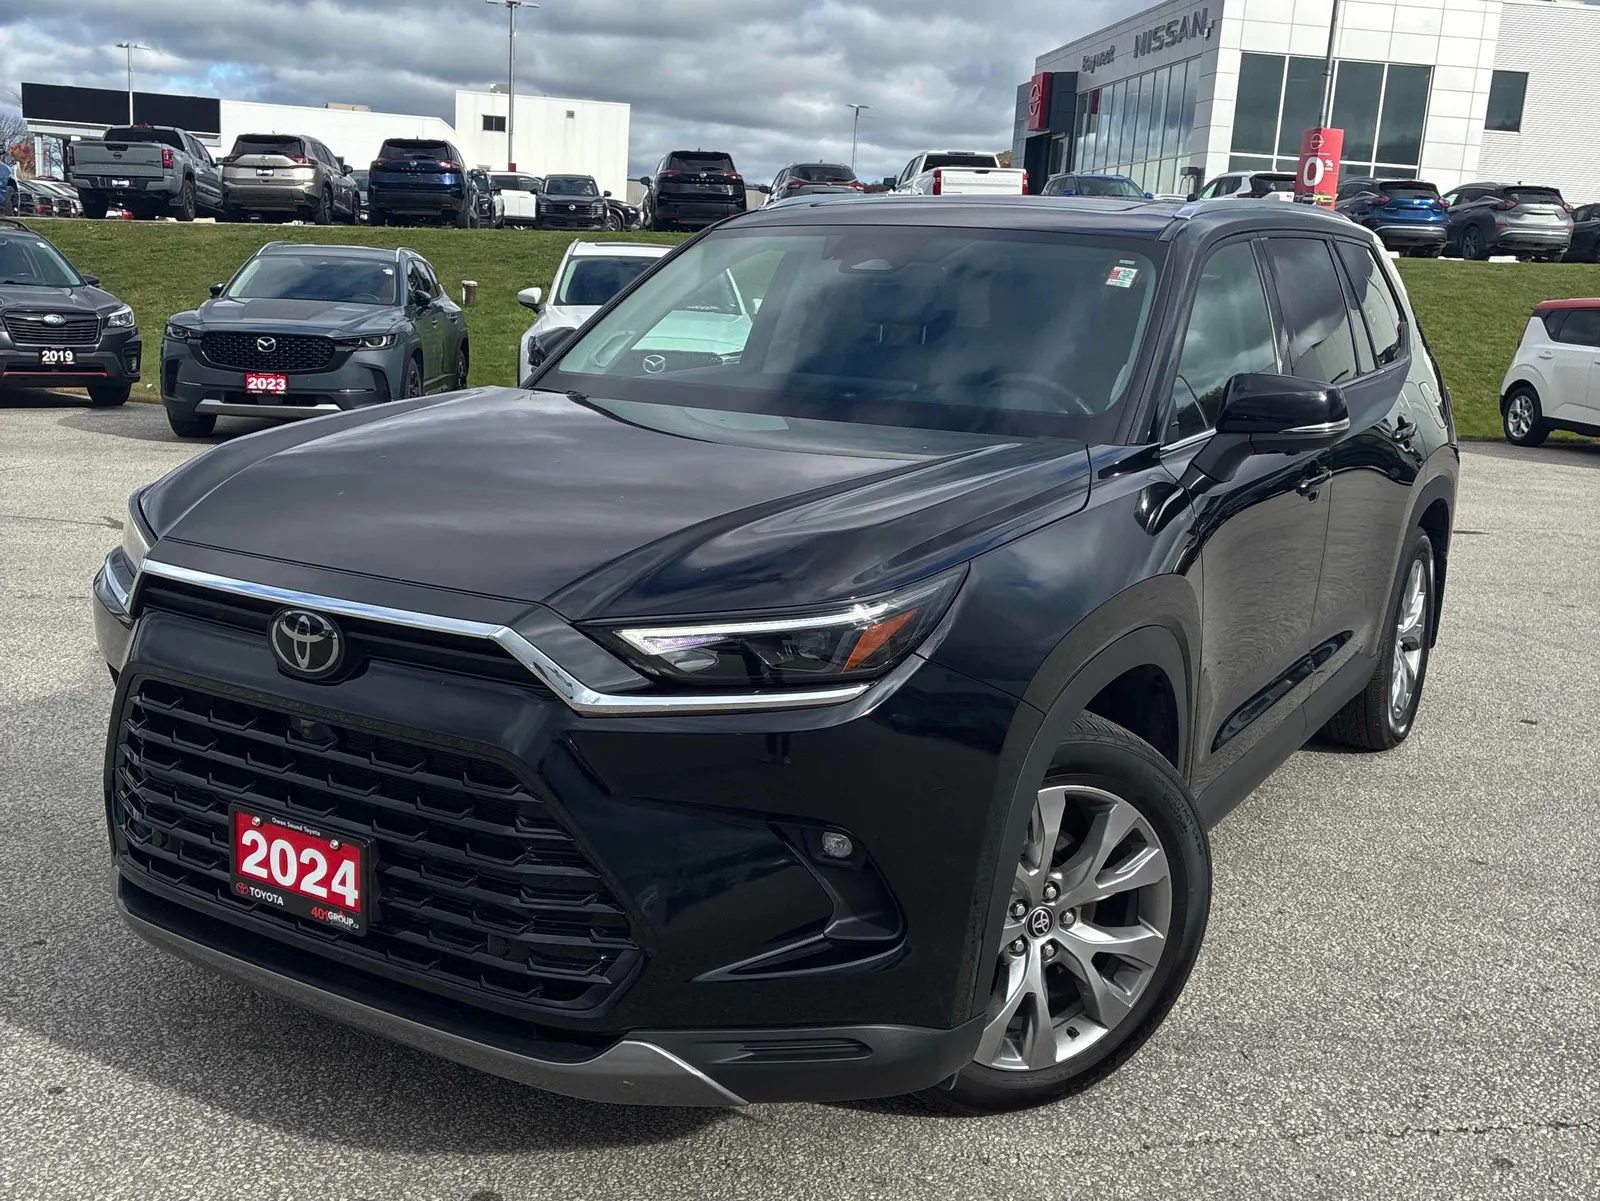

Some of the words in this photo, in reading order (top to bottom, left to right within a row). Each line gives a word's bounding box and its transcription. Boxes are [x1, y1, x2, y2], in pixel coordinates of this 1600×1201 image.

[1133, 8, 1208, 59] NISSAN
[1303, 157, 1325, 187] 0
[41, 350, 74, 361] 2019
[247, 377, 286, 391] 2023
[271, 817, 287, 826] Owen
[287, 822, 303, 831] Sound
[303, 826, 321, 837] Toyota
[241, 829, 358, 907] 2024
[249, 887, 284, 906] TOYOTA
